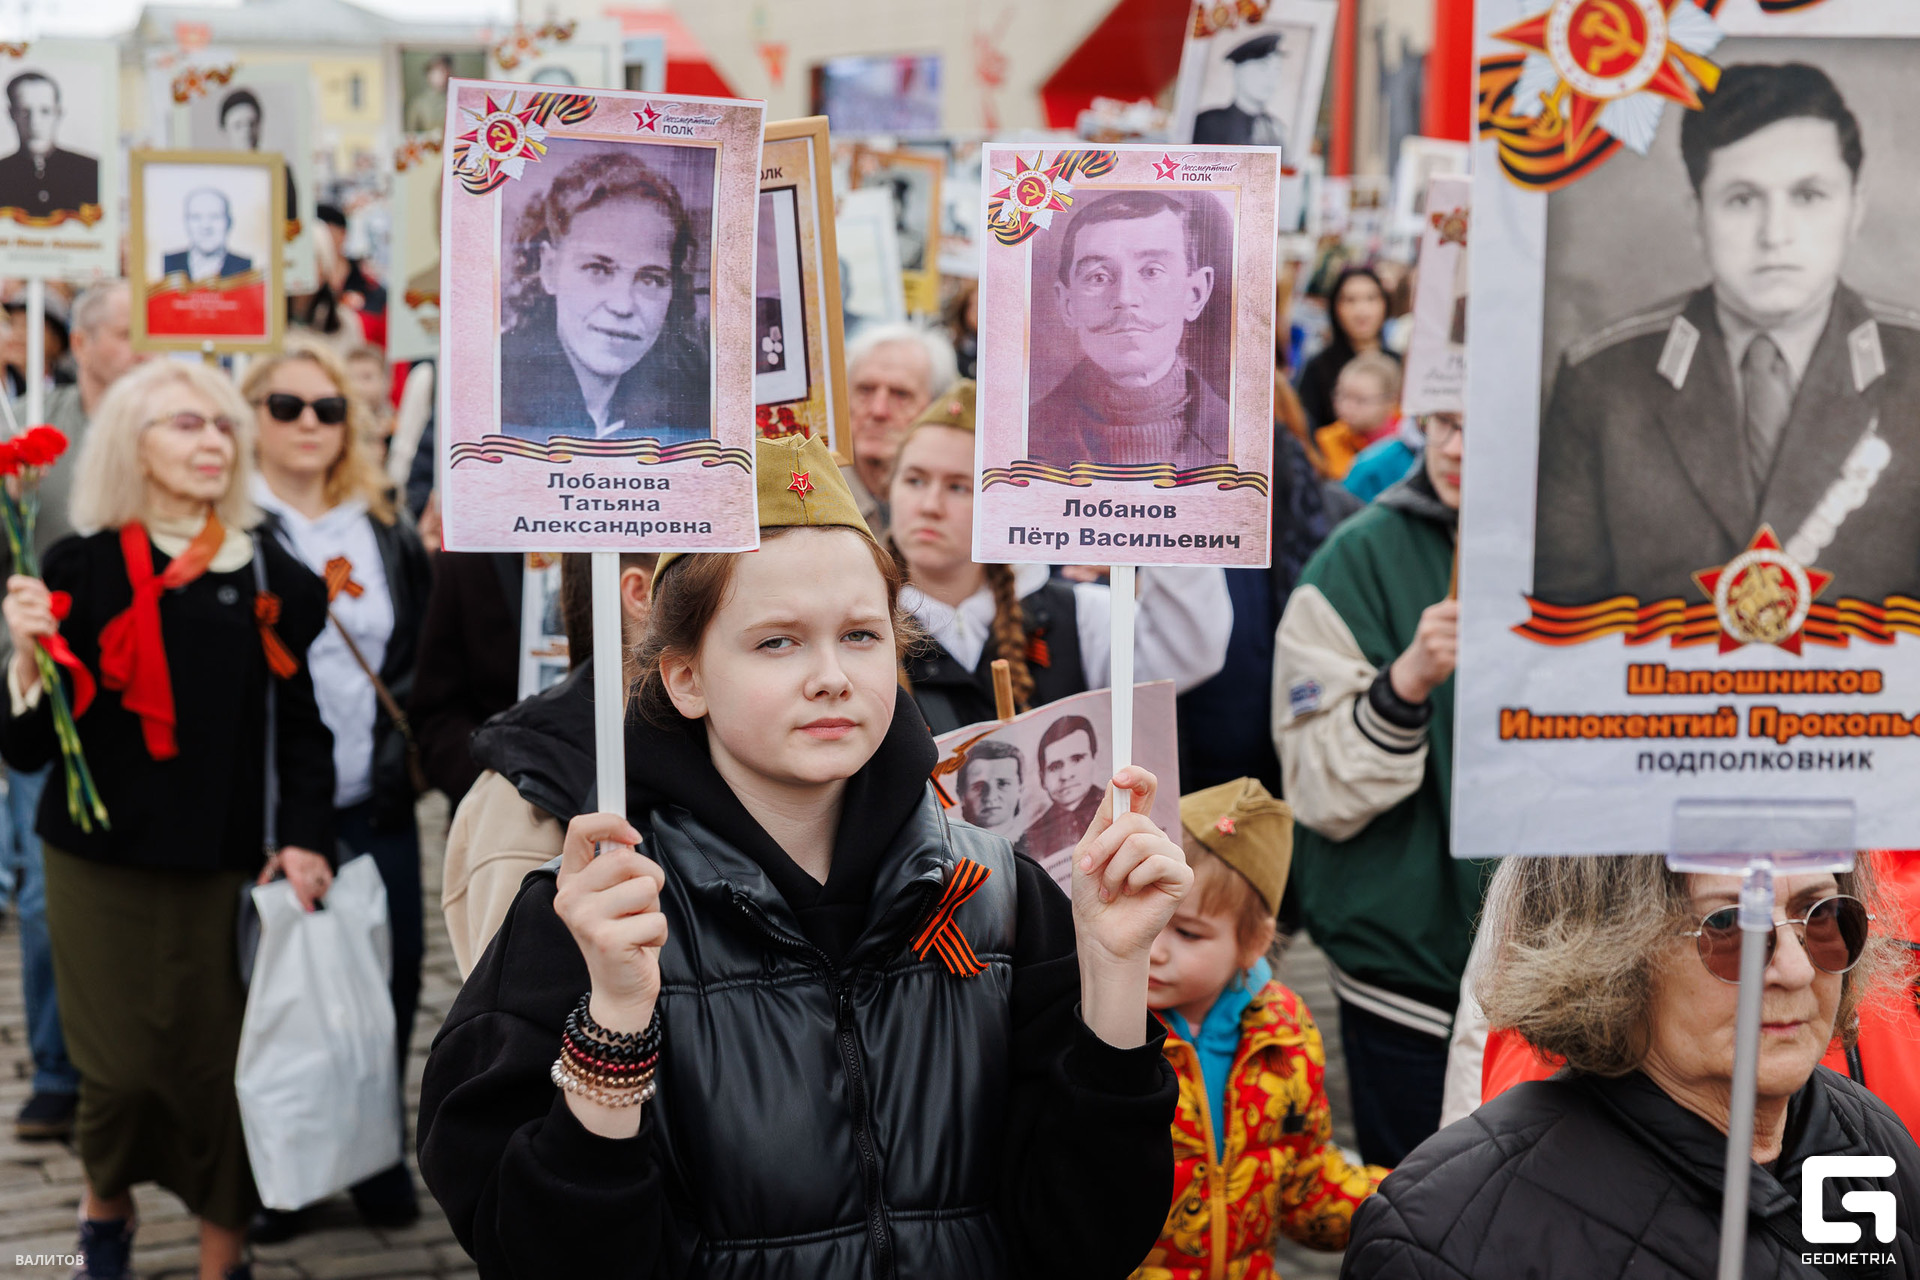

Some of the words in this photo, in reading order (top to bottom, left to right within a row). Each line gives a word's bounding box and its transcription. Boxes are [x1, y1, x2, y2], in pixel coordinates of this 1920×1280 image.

[663, 124, 693, 135] ПОЛК
[1181, 173, 1212, 182] ПОЛК
[547, 472, 670, 490] Лобанова
[559, 495, 660, 512] Татьяна
[1063, 499, 1177, 519] Лобанов
[513, 516, 712, 537] Александровна
[1008, 526, 1070, 550] Пётр
[1079, 528, 1241, 549] Васильевич
[1627, 663, 1883, 695] Шапошников
[1499, 706, 1738, 740] Иннокентий
[1637, 750, 1874, 775] подполковник
